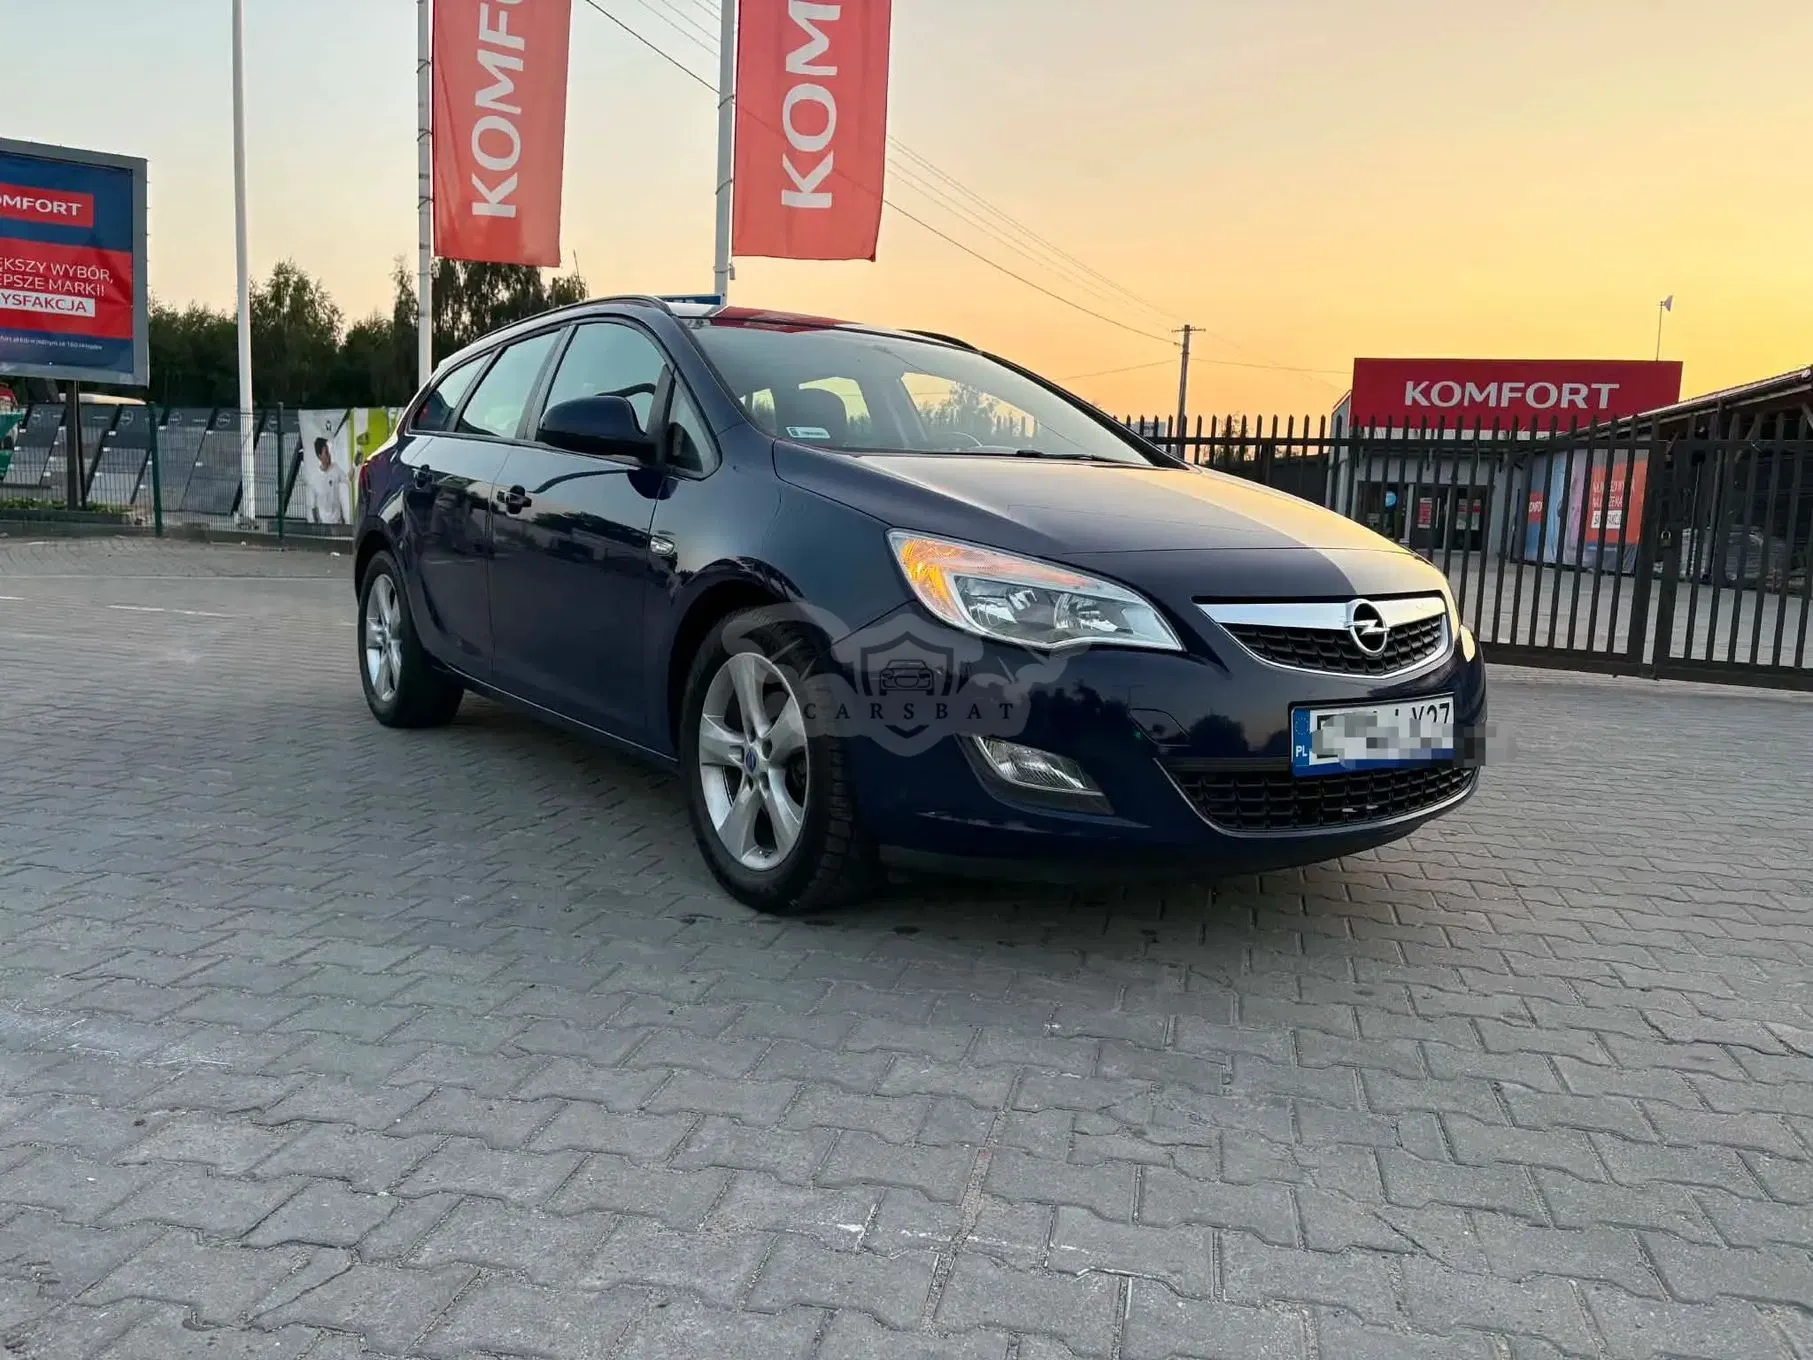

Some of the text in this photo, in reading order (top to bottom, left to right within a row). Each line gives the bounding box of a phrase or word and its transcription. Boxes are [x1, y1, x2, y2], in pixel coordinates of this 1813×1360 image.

[471, 0, 525, 218] KOMF
[781, 0, 841, 209] KOM
[0, 194, 82, 216] MFORT
[0, 273, 104, 297] PSZE MARKI!
[50, 263, 113, 284] WYBÓR,
[1404, 381, 1620, 409] KOMFORT
[1295, 745, 1308, 758] PL
